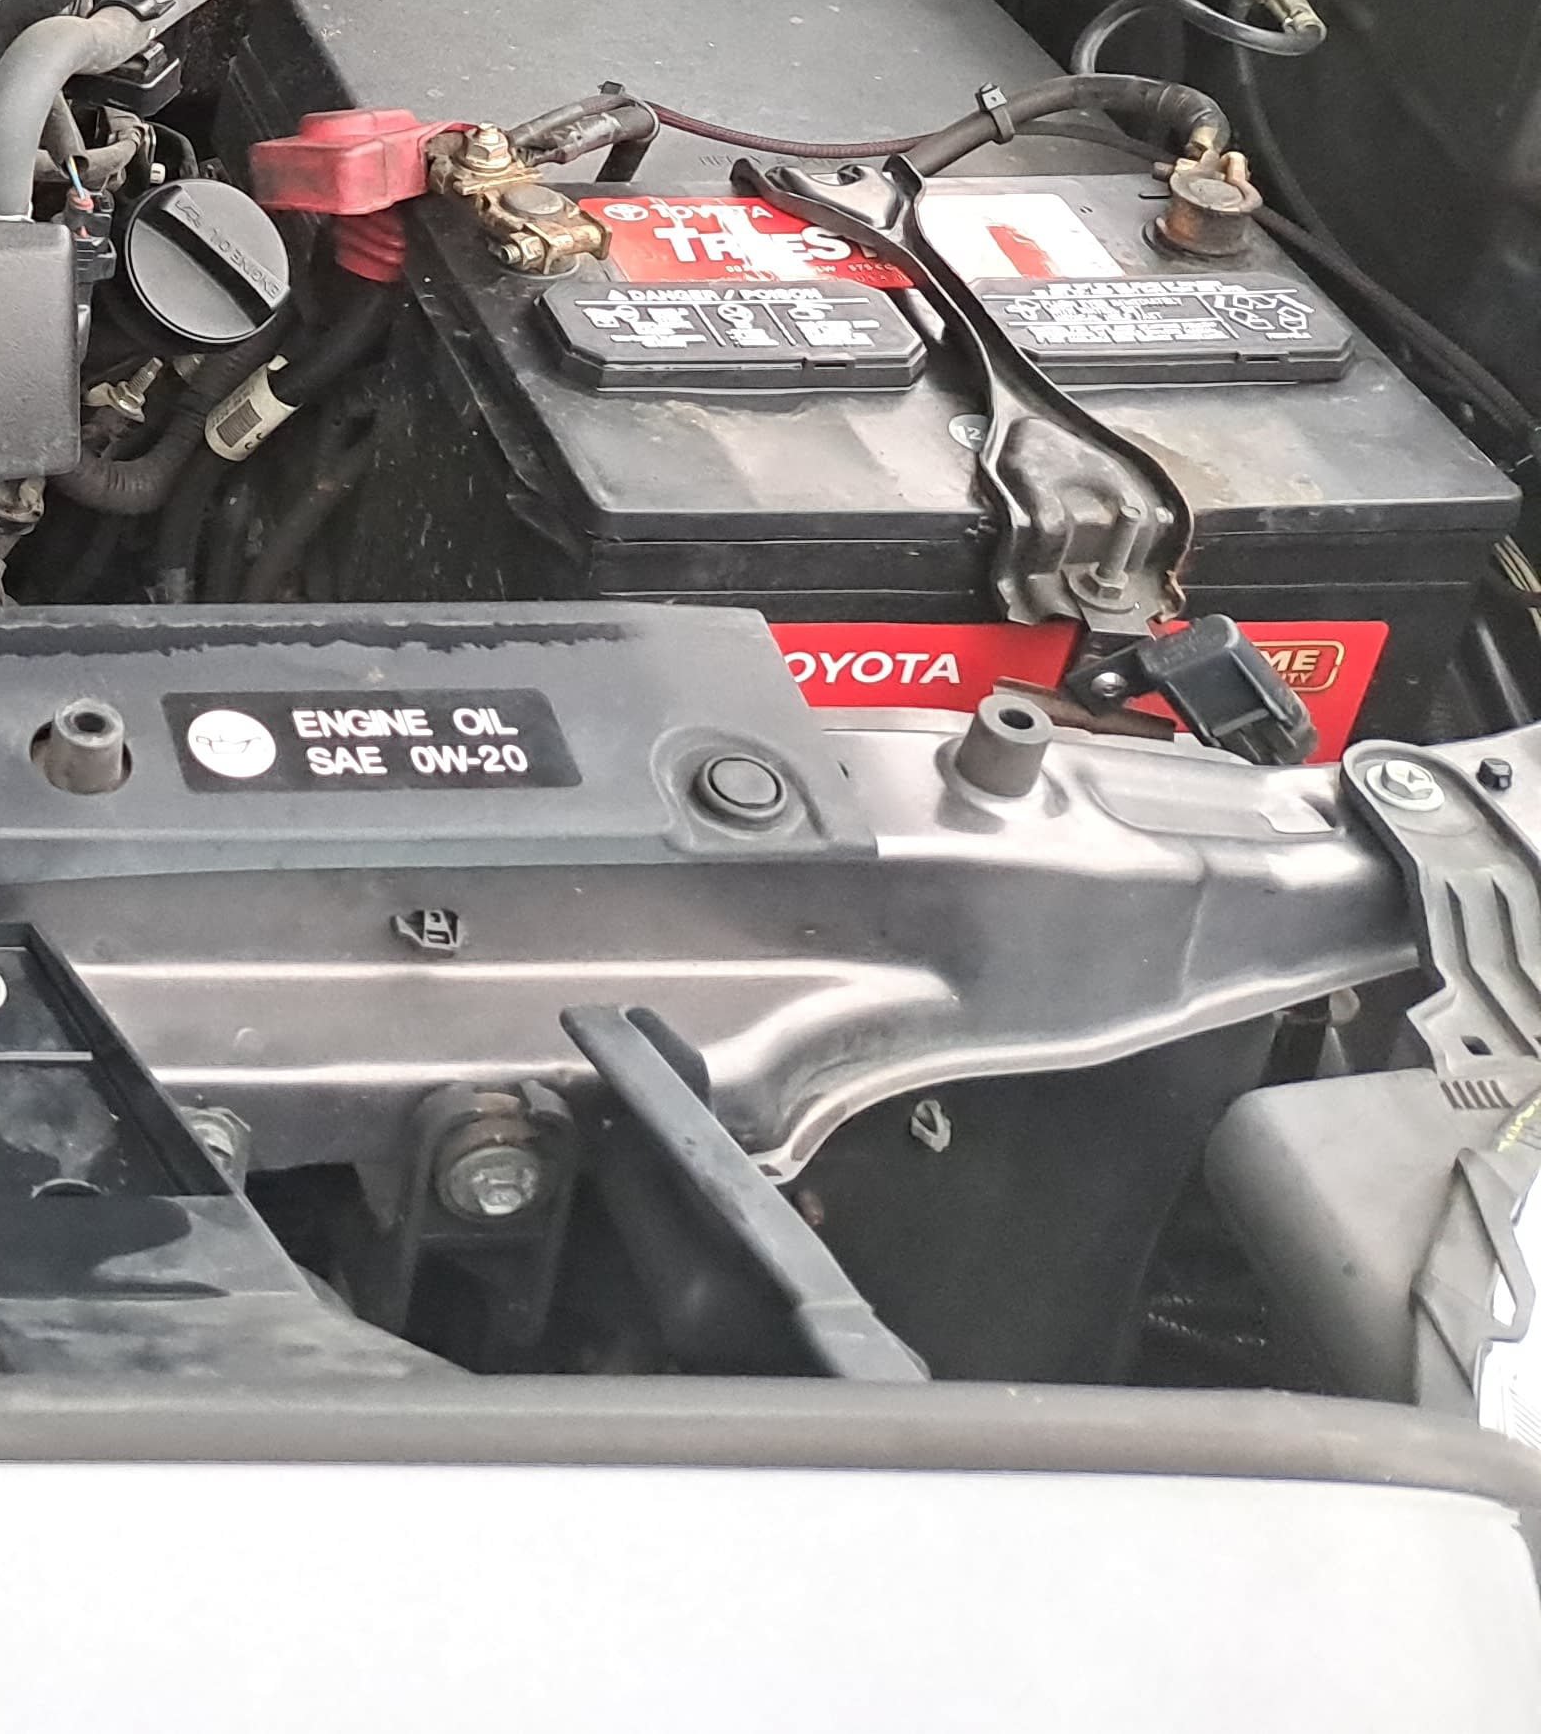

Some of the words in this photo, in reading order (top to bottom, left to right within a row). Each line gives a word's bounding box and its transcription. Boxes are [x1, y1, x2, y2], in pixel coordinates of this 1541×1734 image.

[626, 289, 717, 302] DANGER
[740, 287, 823, 302] POISON
[789, 652, 961, 684] OYOTA
[292, 708, 434, 738] ENGINE
[452, 707, 519, 736] OIL
[306, 746, 388, 774] SAE
[409, 744, 529, 774] 0W-20
